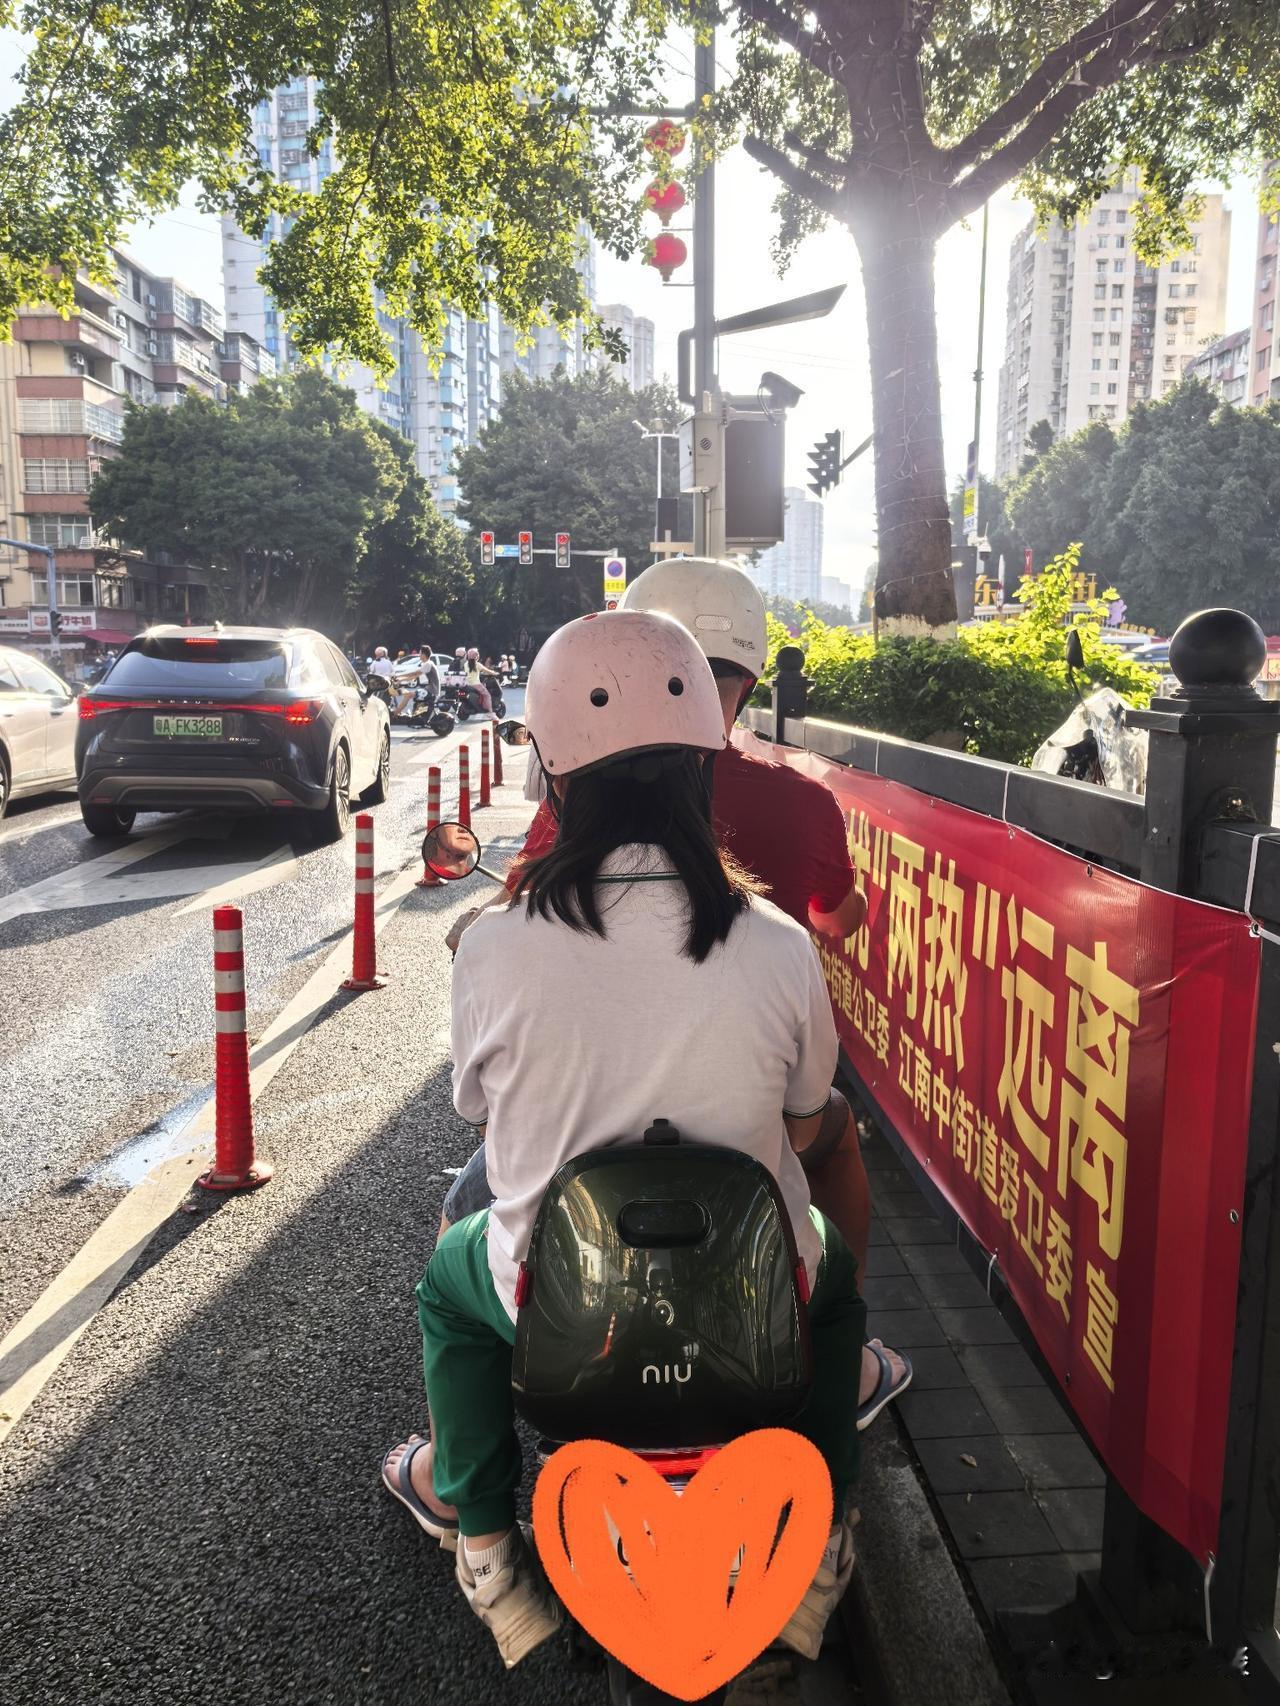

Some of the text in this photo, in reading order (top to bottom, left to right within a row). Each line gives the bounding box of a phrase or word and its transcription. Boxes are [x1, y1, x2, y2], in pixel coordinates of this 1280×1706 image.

[898, 1026, 1073, 1324] 江南中街道爱卫委
[1082, 1260, 1119, 1394] 宣
